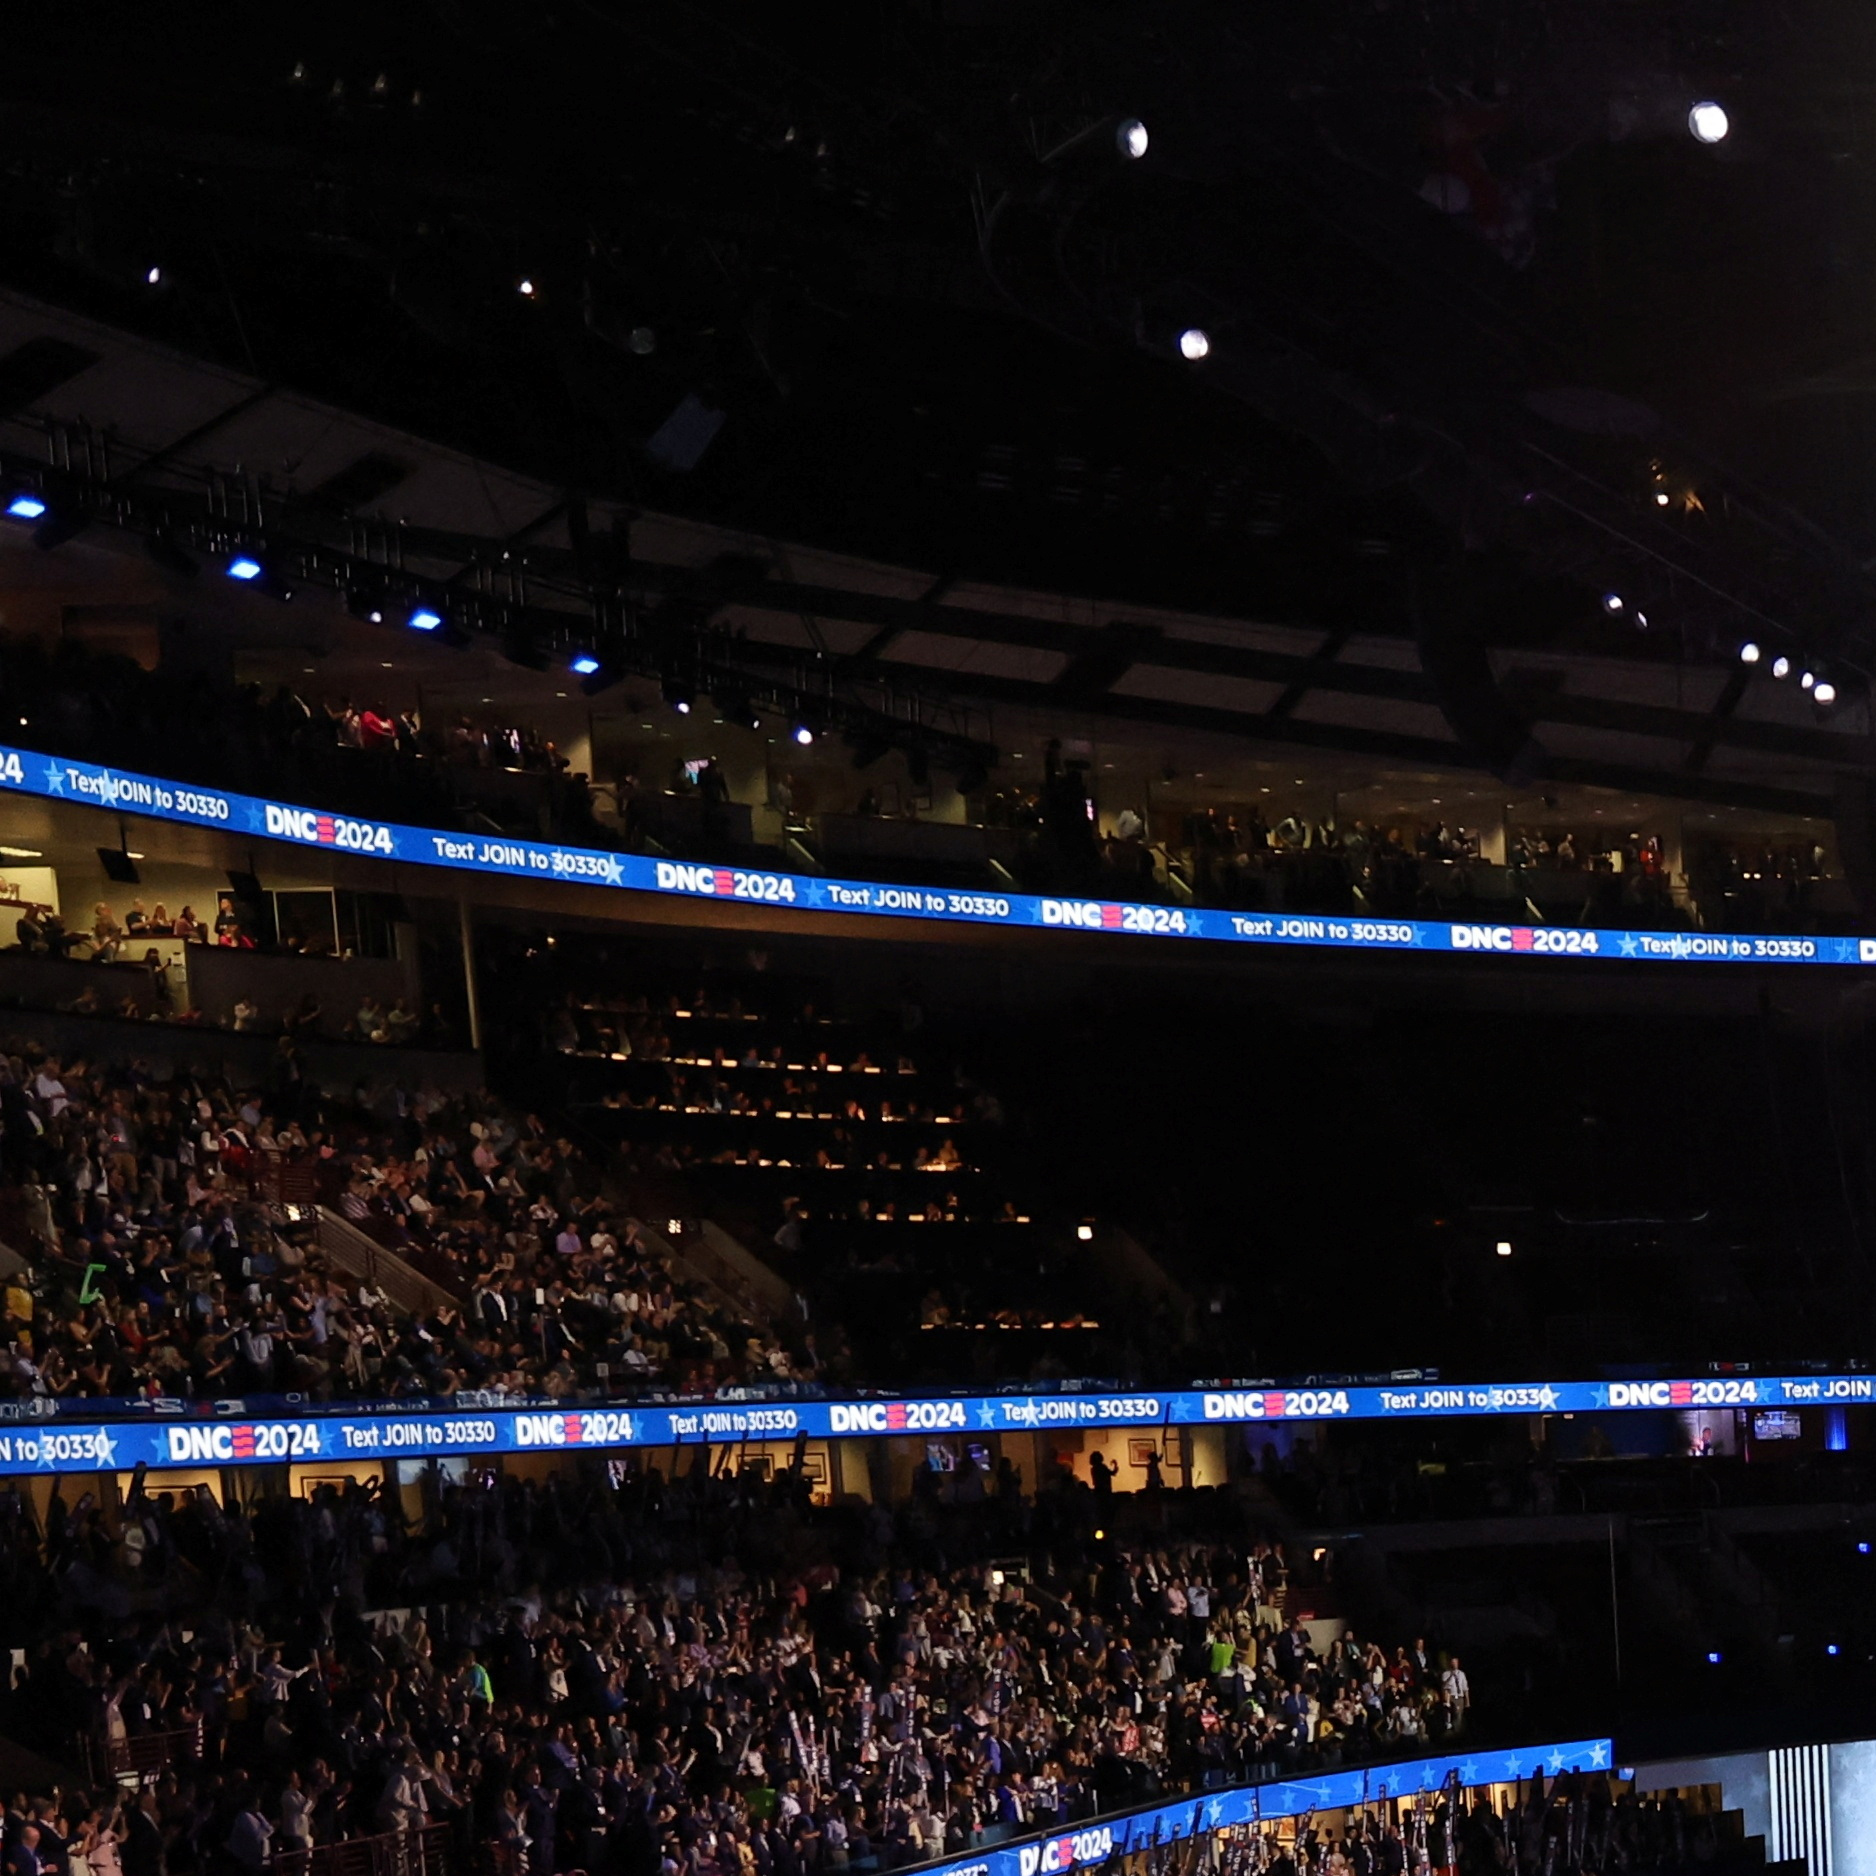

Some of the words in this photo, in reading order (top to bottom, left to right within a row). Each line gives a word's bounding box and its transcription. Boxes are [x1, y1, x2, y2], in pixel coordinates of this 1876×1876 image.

[433, 838, 474, 860] Text
[479, 844, 525, 866] JOIN
[529, 851, 548, 869] to
[552, 852, 608, 877] 30330
[1232, 918, 1272, 935] Text
[1277, 921, 1324, 937] JOIN
[1328, 924, 1348, 938] to
[1352, 924, 1412, 941] 30330
[342, 1426, 379, 1447] Text
[383, 1424, 422, 1446] JOIN
[425, 1425, 442, 1443] to
[445, 1421, 495, 1443] 30330
